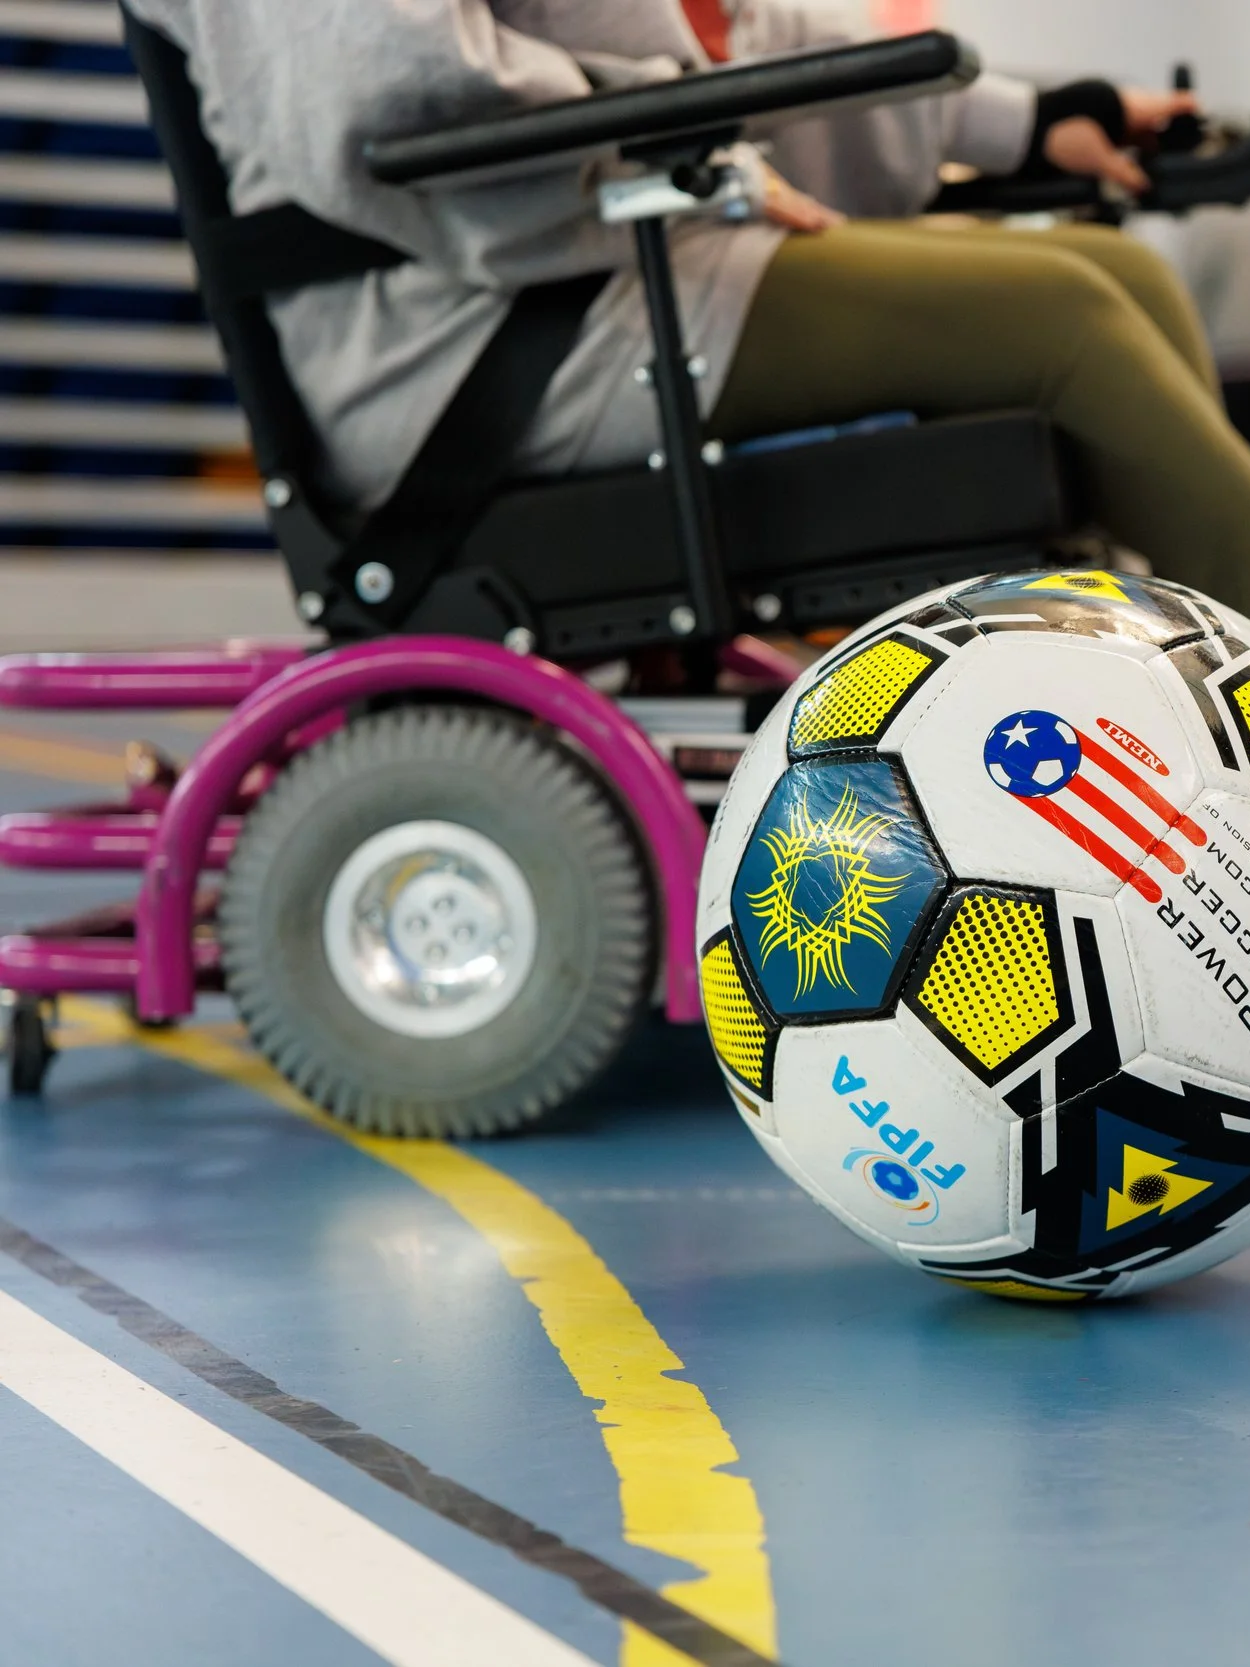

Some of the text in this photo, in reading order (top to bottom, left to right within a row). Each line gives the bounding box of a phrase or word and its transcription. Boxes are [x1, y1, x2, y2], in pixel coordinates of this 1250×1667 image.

[1103, 723, 1163, 770] NEMI
[1202, 804, 1220, 819] OF
[832, 1056, 967, 1190] FIPFA
